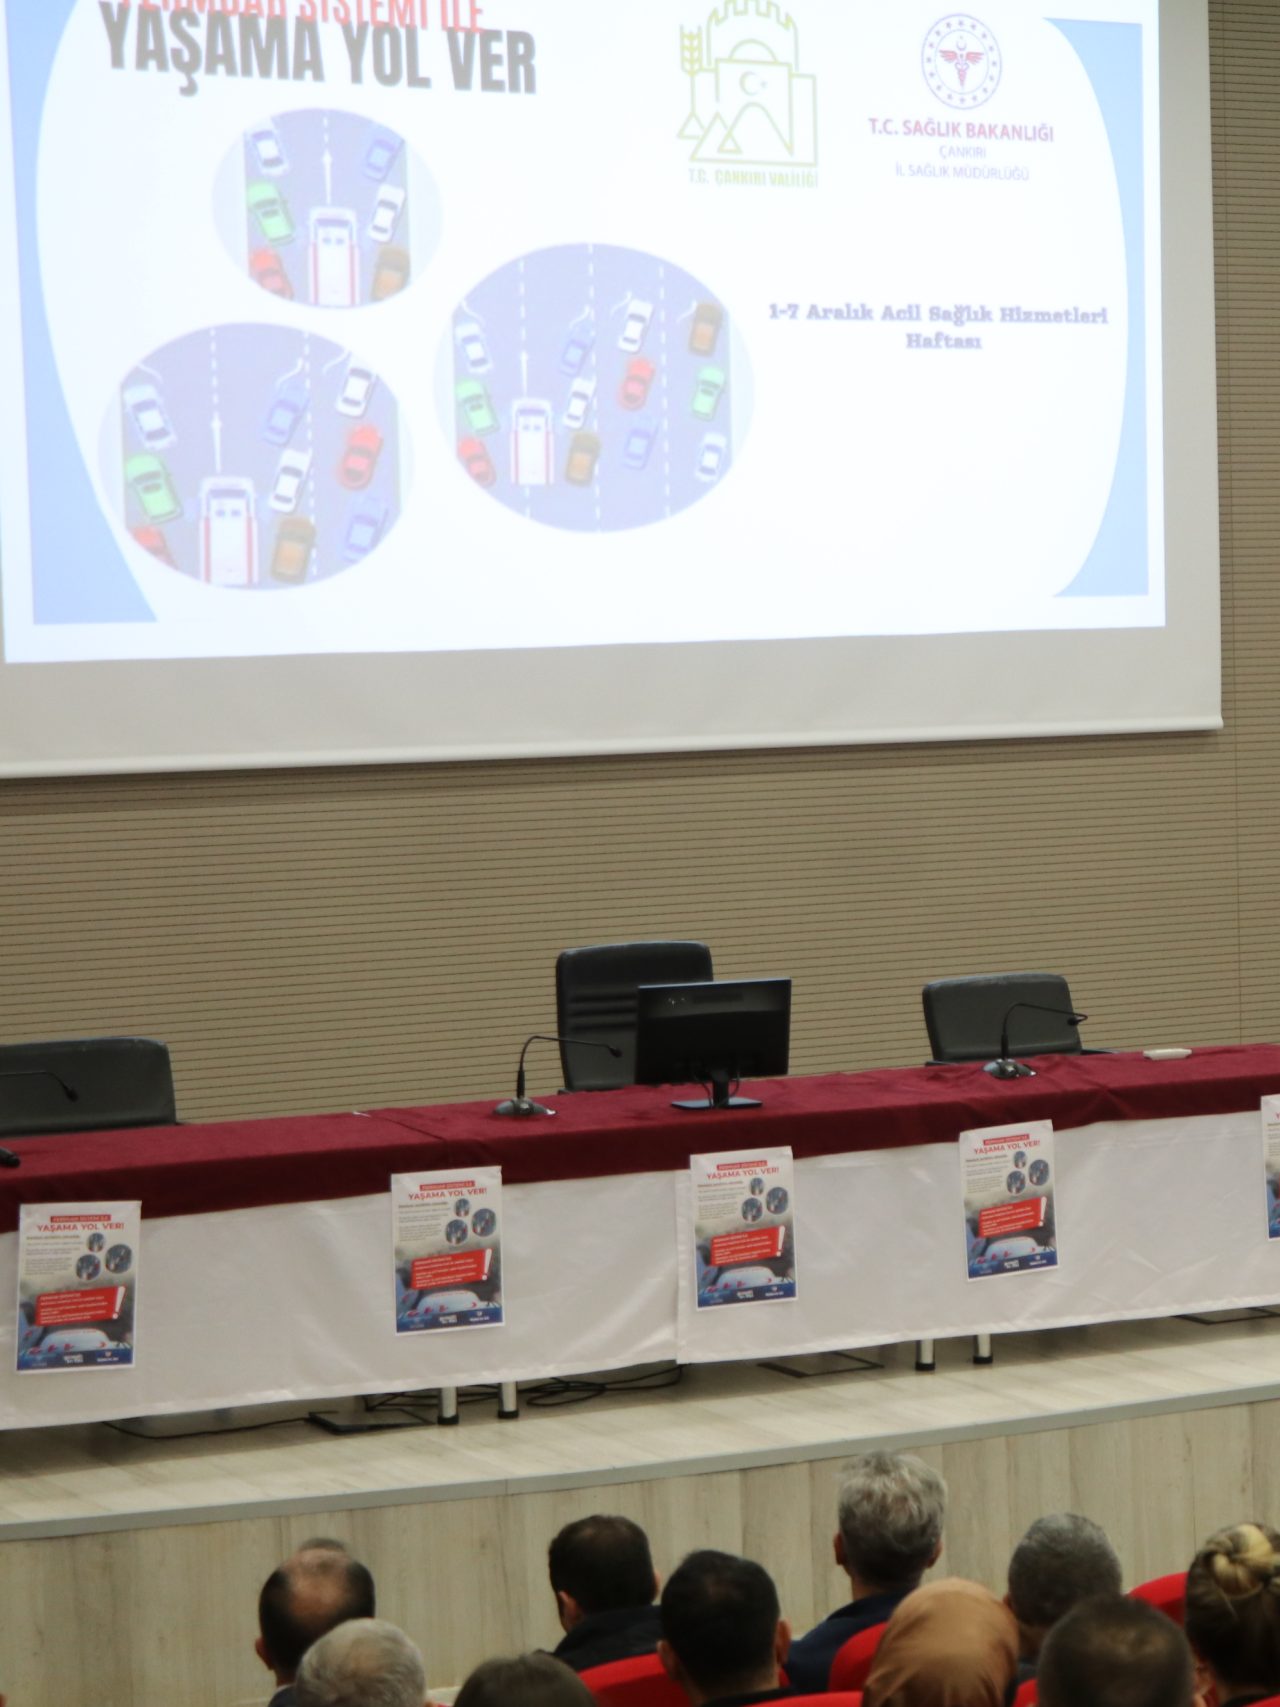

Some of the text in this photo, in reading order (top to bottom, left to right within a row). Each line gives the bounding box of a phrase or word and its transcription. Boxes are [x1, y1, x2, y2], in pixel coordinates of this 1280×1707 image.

[98, 2, 536, 97] YAŞAMA YOL VER
[868, 117, 1054, 142] T.C. SAĞLIK BAKANLIĞI
[939, 145, 987, 160] ÇANKIRI
[908, 162, 950, 179] SAĞLIK
[769, 303, 1109, 327] 1-7 Aralık Acil Sağlık Hizmetleri
[905, 331, 983, 350] Haftası
